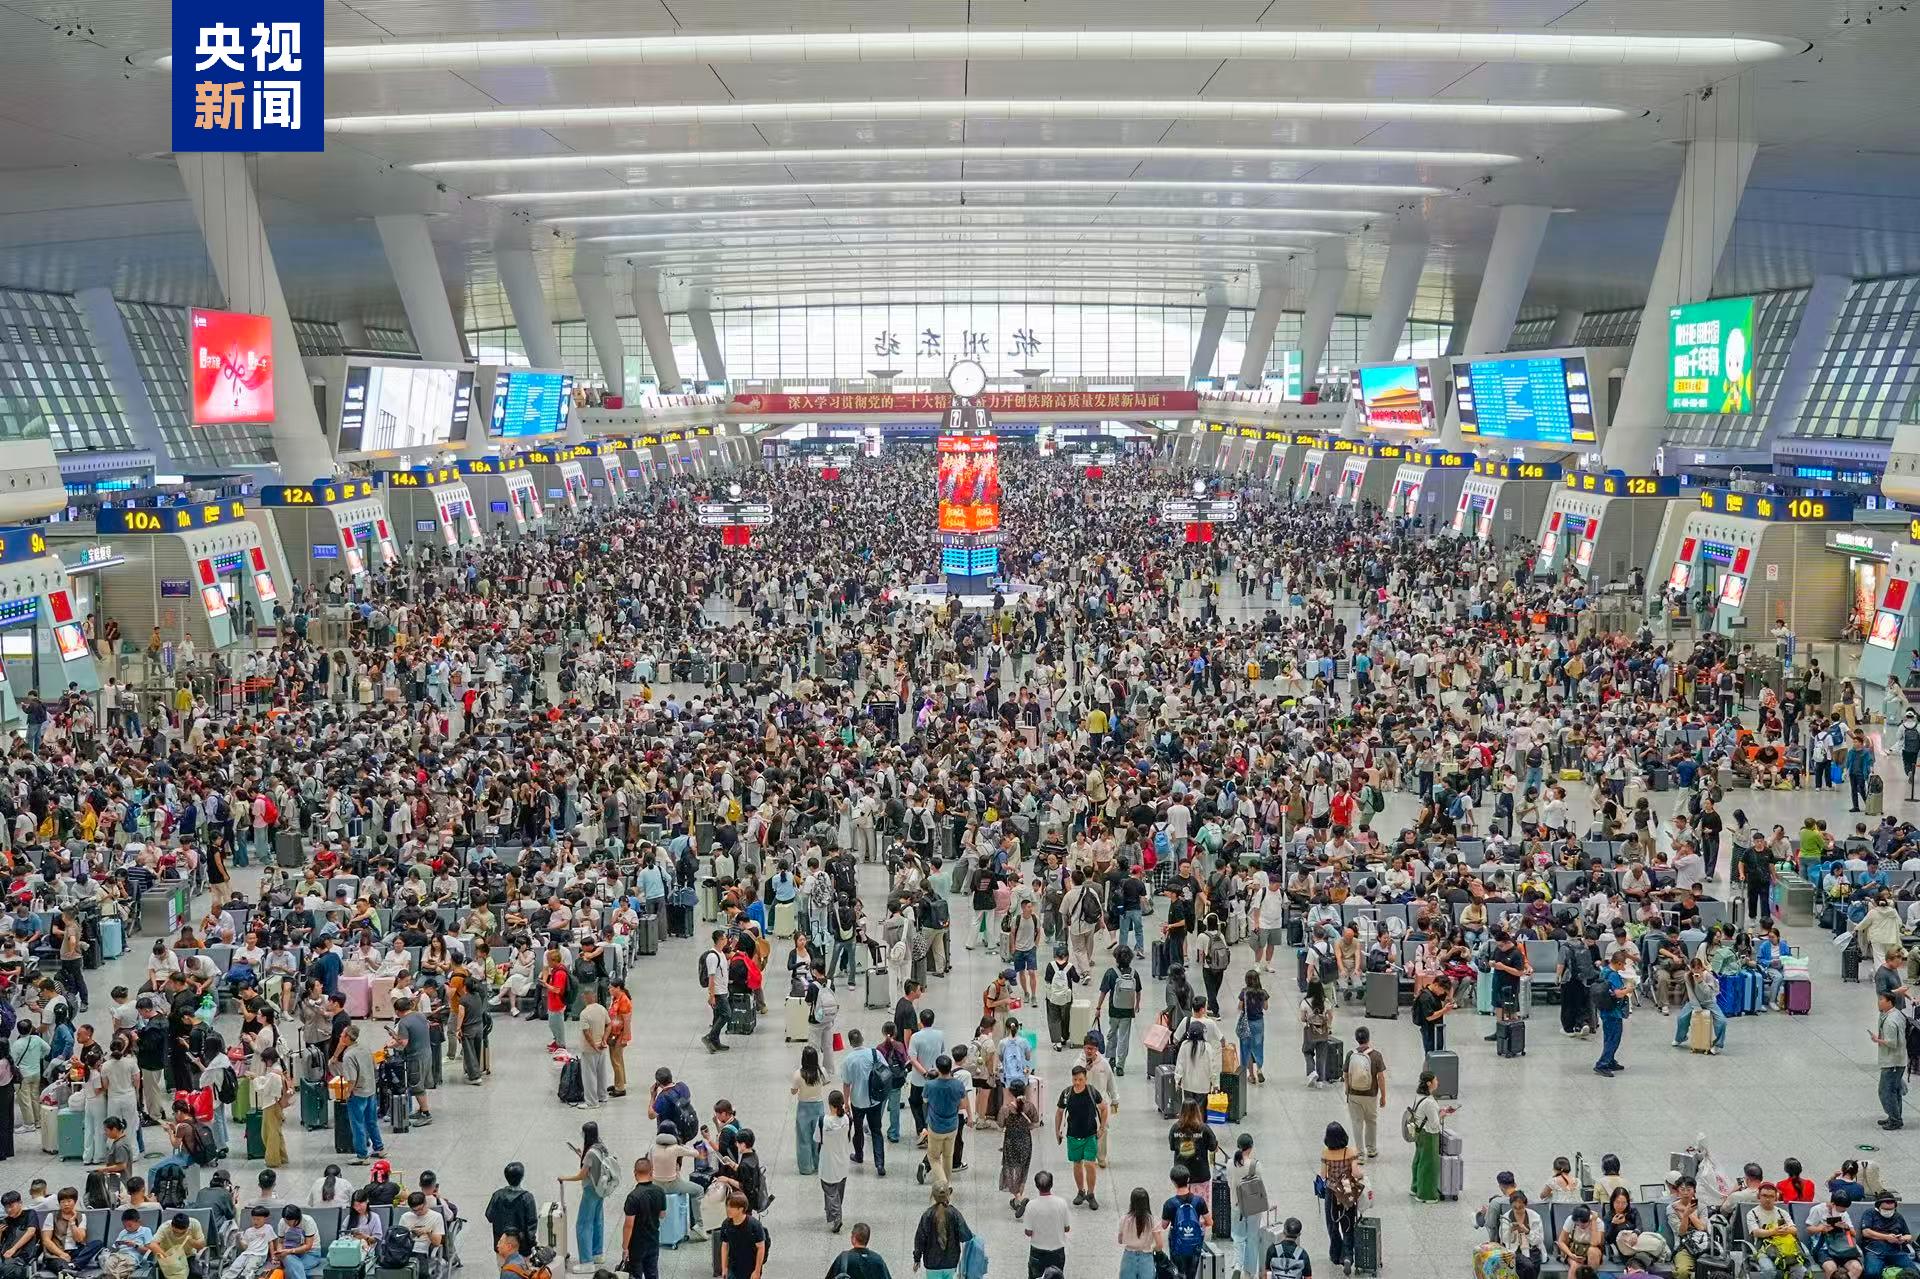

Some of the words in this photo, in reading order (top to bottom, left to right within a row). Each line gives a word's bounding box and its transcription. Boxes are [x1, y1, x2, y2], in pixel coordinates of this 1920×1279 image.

[574, 446, 591, 456] 20A
[1334, 441, 1351, 450] 20B
[1380, 447, 1399, 457] 18B
[529, 453, 548, 463] 18A
[1440, 455, 1461, 466] 16B
[469, 461, 491, 472] 16A
[1518, 465, 1543, 478] 14B
[392, 473, 418, 485] 14A
[1627, 479, 1656, 494] 12B
[284, 489, 313, 503] 12A
[1700, 492, 1713, 508] 11B
[232, 502, 245, 517] 11A
[1757, 499, 1771, 516] 10B
[1788, 499, 1824, 518] 10B
[125, 512, 161, 530] 10A
[177, 510, 191, 527] 10A
[31, 533, 45, 553] 9A
